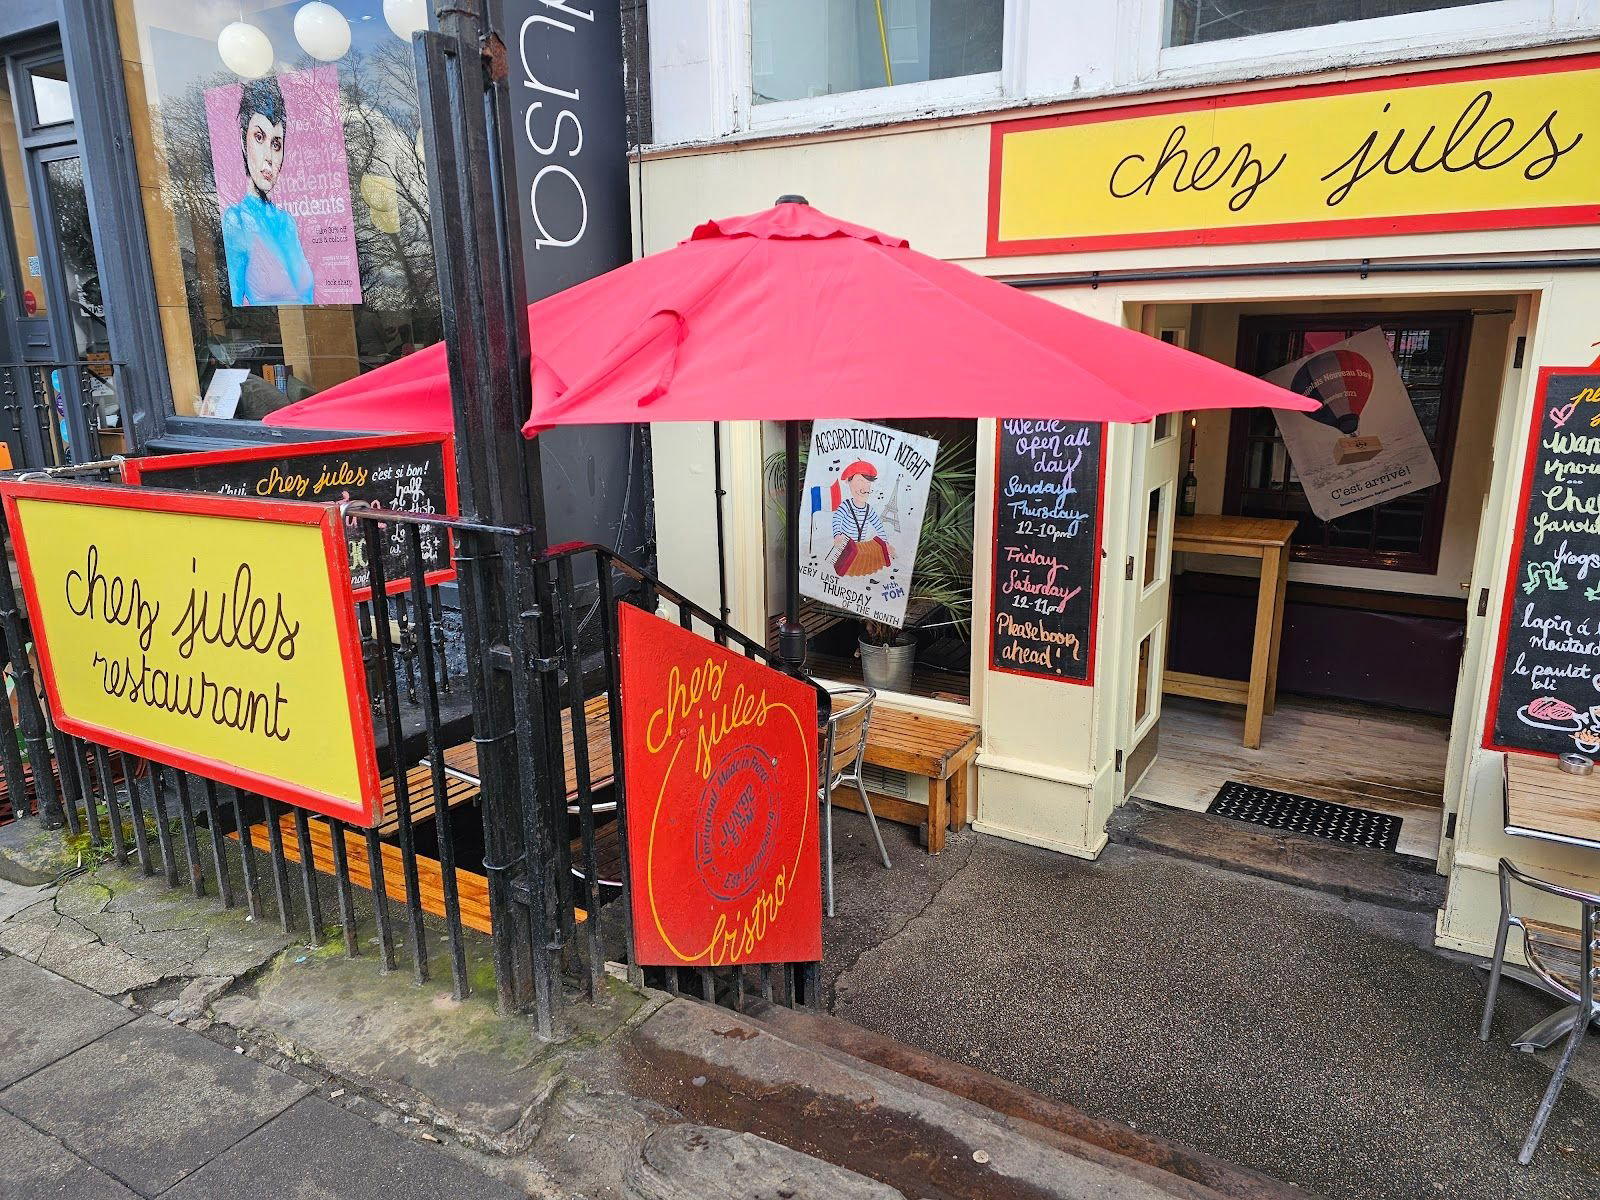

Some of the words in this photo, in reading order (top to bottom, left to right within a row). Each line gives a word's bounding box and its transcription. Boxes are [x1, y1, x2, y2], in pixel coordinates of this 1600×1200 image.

[519, 0, 595, 250] usa
[1110, 124, 1287, 212] chez
[1321, 90, 1583, 207] jules
[1323, 369, 1356, 381] Nouveau
[1356, 369, 1372, 380] Day
[1003, 419, 1033, 435] We
[1035, 419, 1065, 433] are
[1064, 428, 1091, 447] all
[371, 466, 393, 482] c'est
[394, 464, 405, 479] si
[406, 460, 430, 477] bon!
[815, 428, 895, 457] ACCORDIONIST
[893, 441, 932, 480] NIGHT
[1034, 447, 1083, 490] day
[256, 467, 309, 497] chez
[313, 461, 368, 494] jules
[1004, 475, 1077, 509] Sunday
[1331, 483, 1363, 499] C'est
[1365, 465, 1412, 489] arrivé!
[1007, 500, 1089, 537] Thursday
[799, 565, 818, 578] VERY
[820, 571, 840, 584] LAST
[1004, 544, 1069, 585] Friday
[66, 545, 160, 651] chez
[172, 557, 300, 661] jules
[823, 581, 872, 606] THURSDAY
[881, 587, 905, 602] TOM
[1002, 569, 1082, 613] Saturday
[841, 600, 853, 608] OF
[856, 603, 871, 615] THE
[873, 610, 900, 626] MONTH
[996, 612, 1039, 642] Please
[1521, 602, 1573, 638] lapin
[1511, 652, 1530, 675] le
[1531, 663, 1591, 683] poulet
[93, 651, 291, 741] restaurant
[647, 657, 728, 753] chez
[694, 682, 770, 780] jules
[710, 864, 787, 967] bistro
